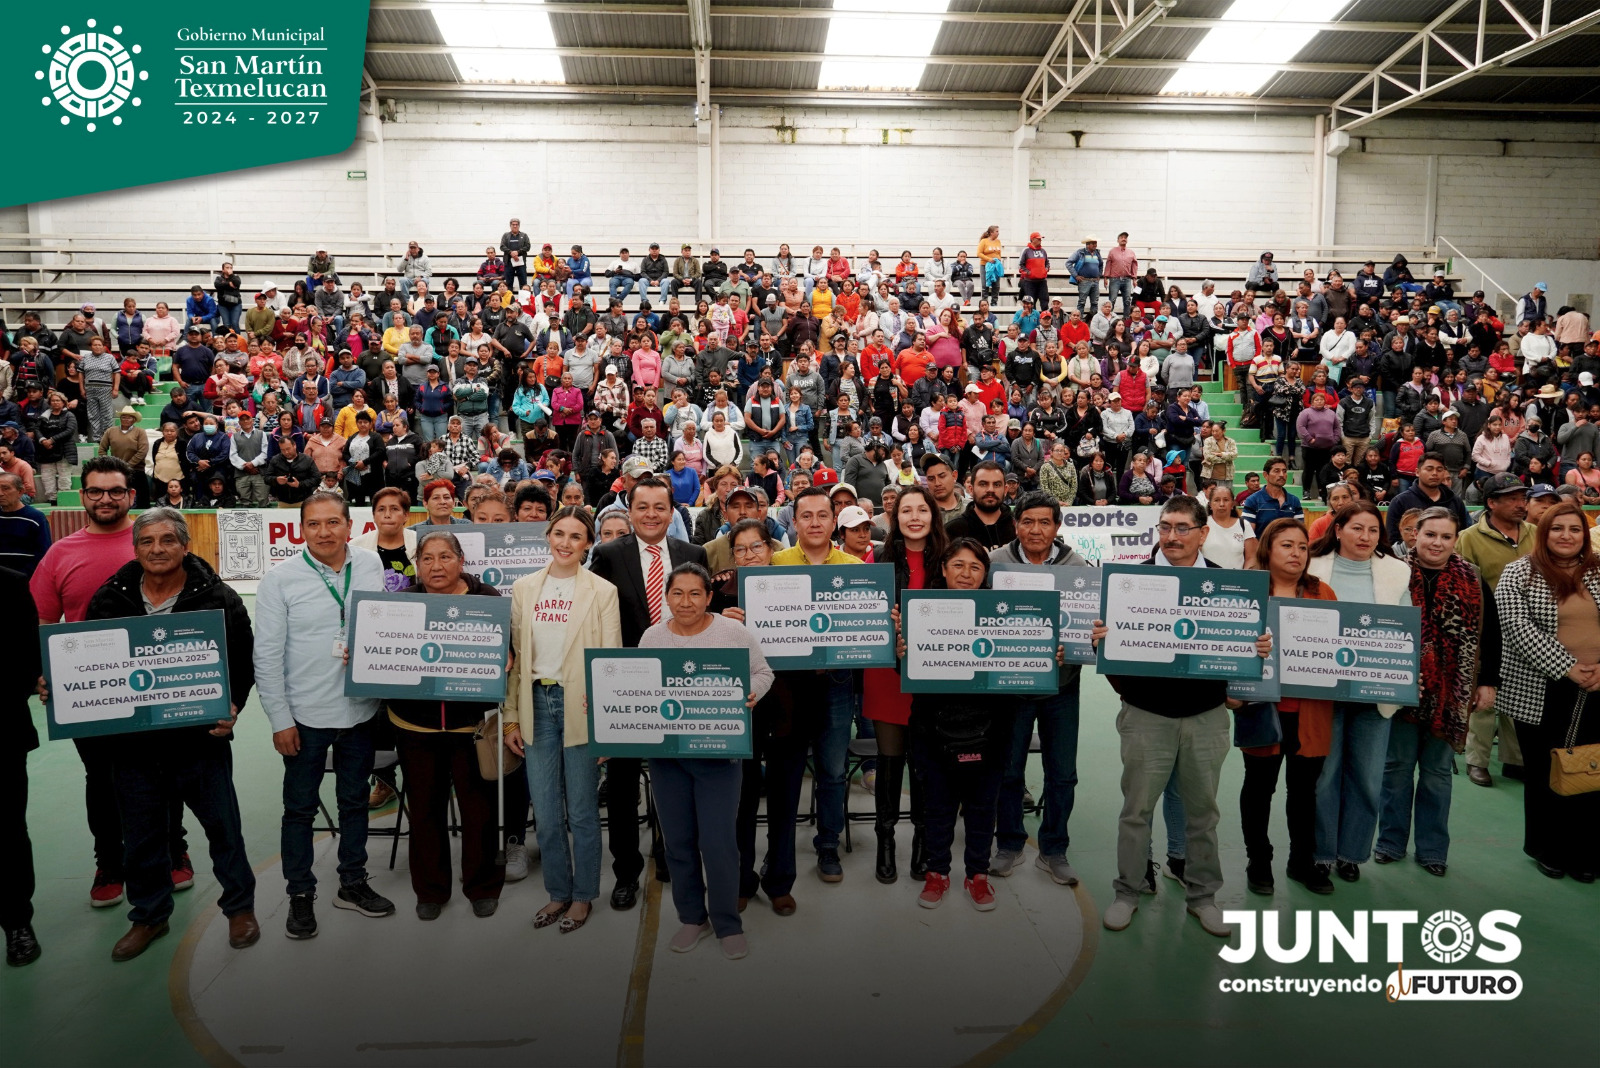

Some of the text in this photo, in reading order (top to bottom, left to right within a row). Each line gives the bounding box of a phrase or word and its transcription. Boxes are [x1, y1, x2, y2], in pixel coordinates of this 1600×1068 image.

[1059, 510, 1138, 527] eporte
[269, 522, 377, 544] PUA
[489, 571, 495, 582] 1
[816, 591, 888, 600] PROGRAMA
[534, 600, 572, 611] BIARRIT
[1182, 596, 1260, 609] PROGRAMA
[536, 612, 568, 622] FRANC
[755, 620, 782, 628] VALE
[785, 619, 807, 627] POR
[816, 617, 822, 629] 1
[979, 617, 1053, 626] PROGRAMA
[429, 621, 502, 633] PROGRAMA
[1116, 621, 1144, 630] VALE
[1148, 623, 1171, 632] POR
[1181, 622, 1188, 635] 1
[761, 635, 843, 644] ALMACENAMIENTO
[1343, 628, 1414, 641] PROGRAMA
[134, 640, 218, 656] PROGRAMA
[979, 642, 985, 653] 1
[1120, 640, 1208, 650] ALMACENAMIENTO
[1344, 639, 1382, 648] VIVIENDA
[364, 646, 391, 654] VALE
[395, 647, 418, 655] POR
[427, 647, 433, 658] 1
[445, 650, 477, 658] TINACO
[1282, 649, 1413, 666] VALE POR 1 TINACO PARA
[139, 656, 183, 667] VIVIENDA
[368, 664, 454, 673] ALMACENAMIENTO
[1287, 666, 1368, 678] ALMACENAMIENTO
[1384, 672, 1409, 681] AGUA
[64, 682, 96, 692] VALE
[101, 678, 126, 688] POR
[137, 674, 144, 686] 1
[157, 673, 193, 683] TINACO
[666, 677, 743, 687] PROGRAMA
[72, 692, 170, 709] ALMACENAMIENTO
[189, 687, 217, 696] AGUA
[175, 709, 204, 718] FUTURO
[667, 703, 674, 716] 1
